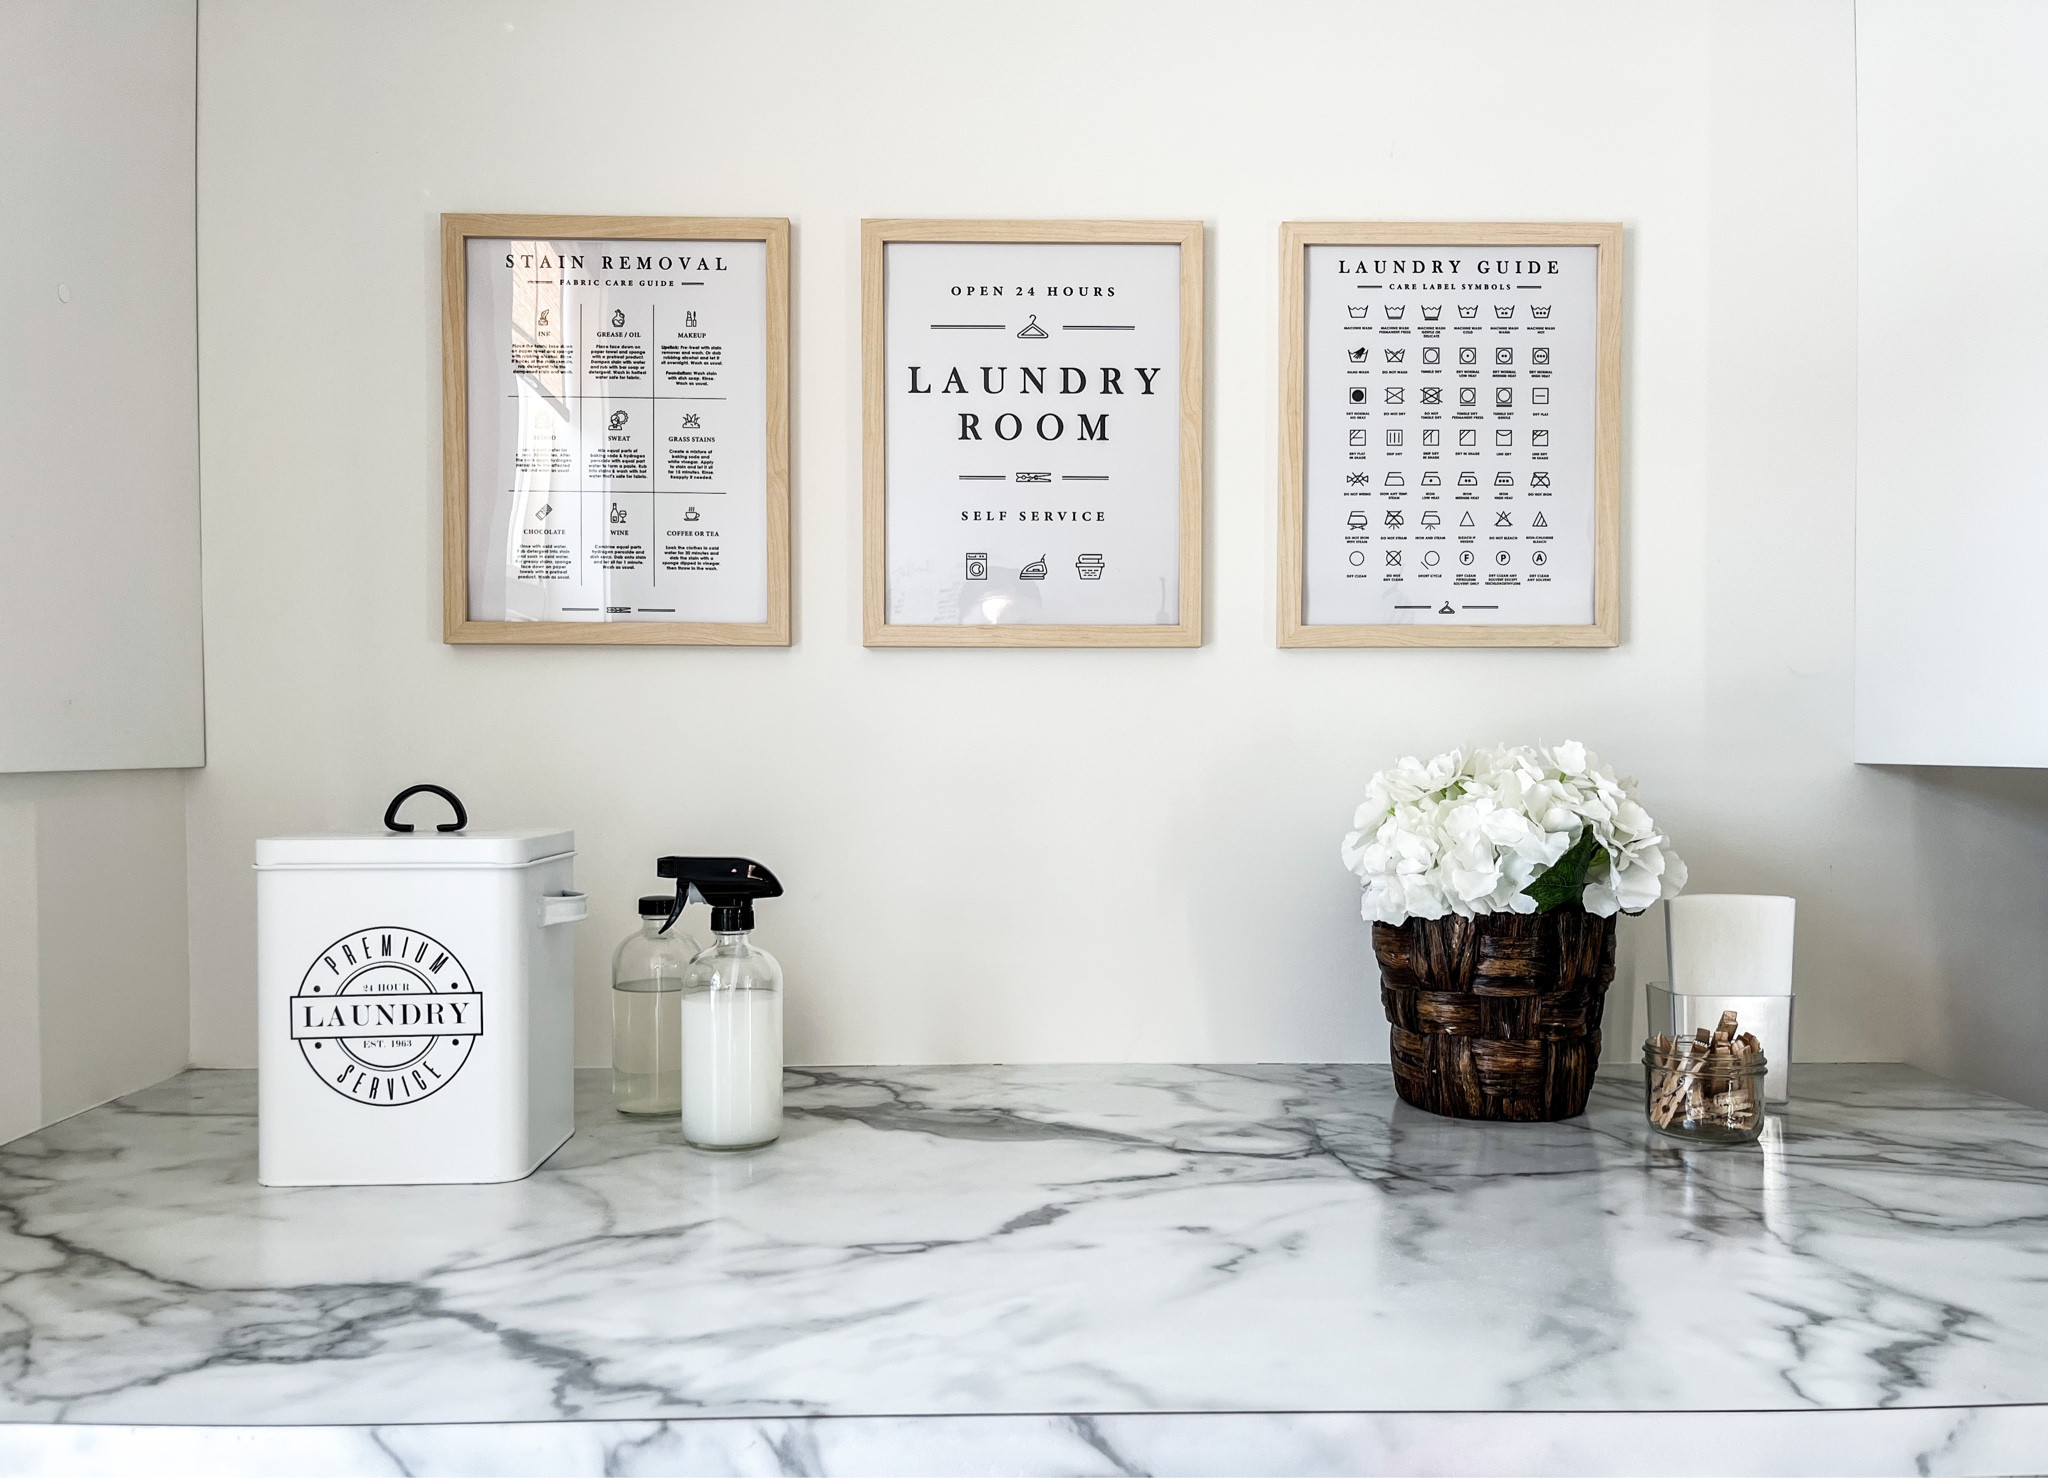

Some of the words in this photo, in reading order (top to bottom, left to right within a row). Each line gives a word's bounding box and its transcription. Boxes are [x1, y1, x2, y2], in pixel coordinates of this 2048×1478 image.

[505, 254, 585, 270] STAIN
[601, 256, 728, 271] REMOVAL
[1338, 260, 1462, 274] LAUNDRY
[1477, 260, 1559, 274] GUIDE
[559, 279, 600, 287] FABRIC
[605, 279, 634, 287] CARE
[639, 279, 675, 287] GUIDE
[950, 286, 1005, 297] OPEN
[1015, 286, 1036, 297] 24
[1047, 286, 1116, 297] HOURS
[907, 366, 1161, 396] LAUNDRY
[957, 413, 1110, 441] ROOM
[961, 510, 1008, 522] SELF
[1019, 510, 1106, 522] SERVICE
[1464, 554, 1469, 562] F
[1500, 554, 1506, 562] P
[1536, 554, 1543, 562] A
[323, 934, 450, 976] PREMIUM
[362, 983, 374, 992] 24
[378, 983, 410, 992] HOUR
[303, 1002, 470, 1028] LAUNDRY
[363, 1040, 386, 1049] EST.
[391, 1039, 412, 1048] 1963
[336, 1060, 442, 1100] SERVICE
